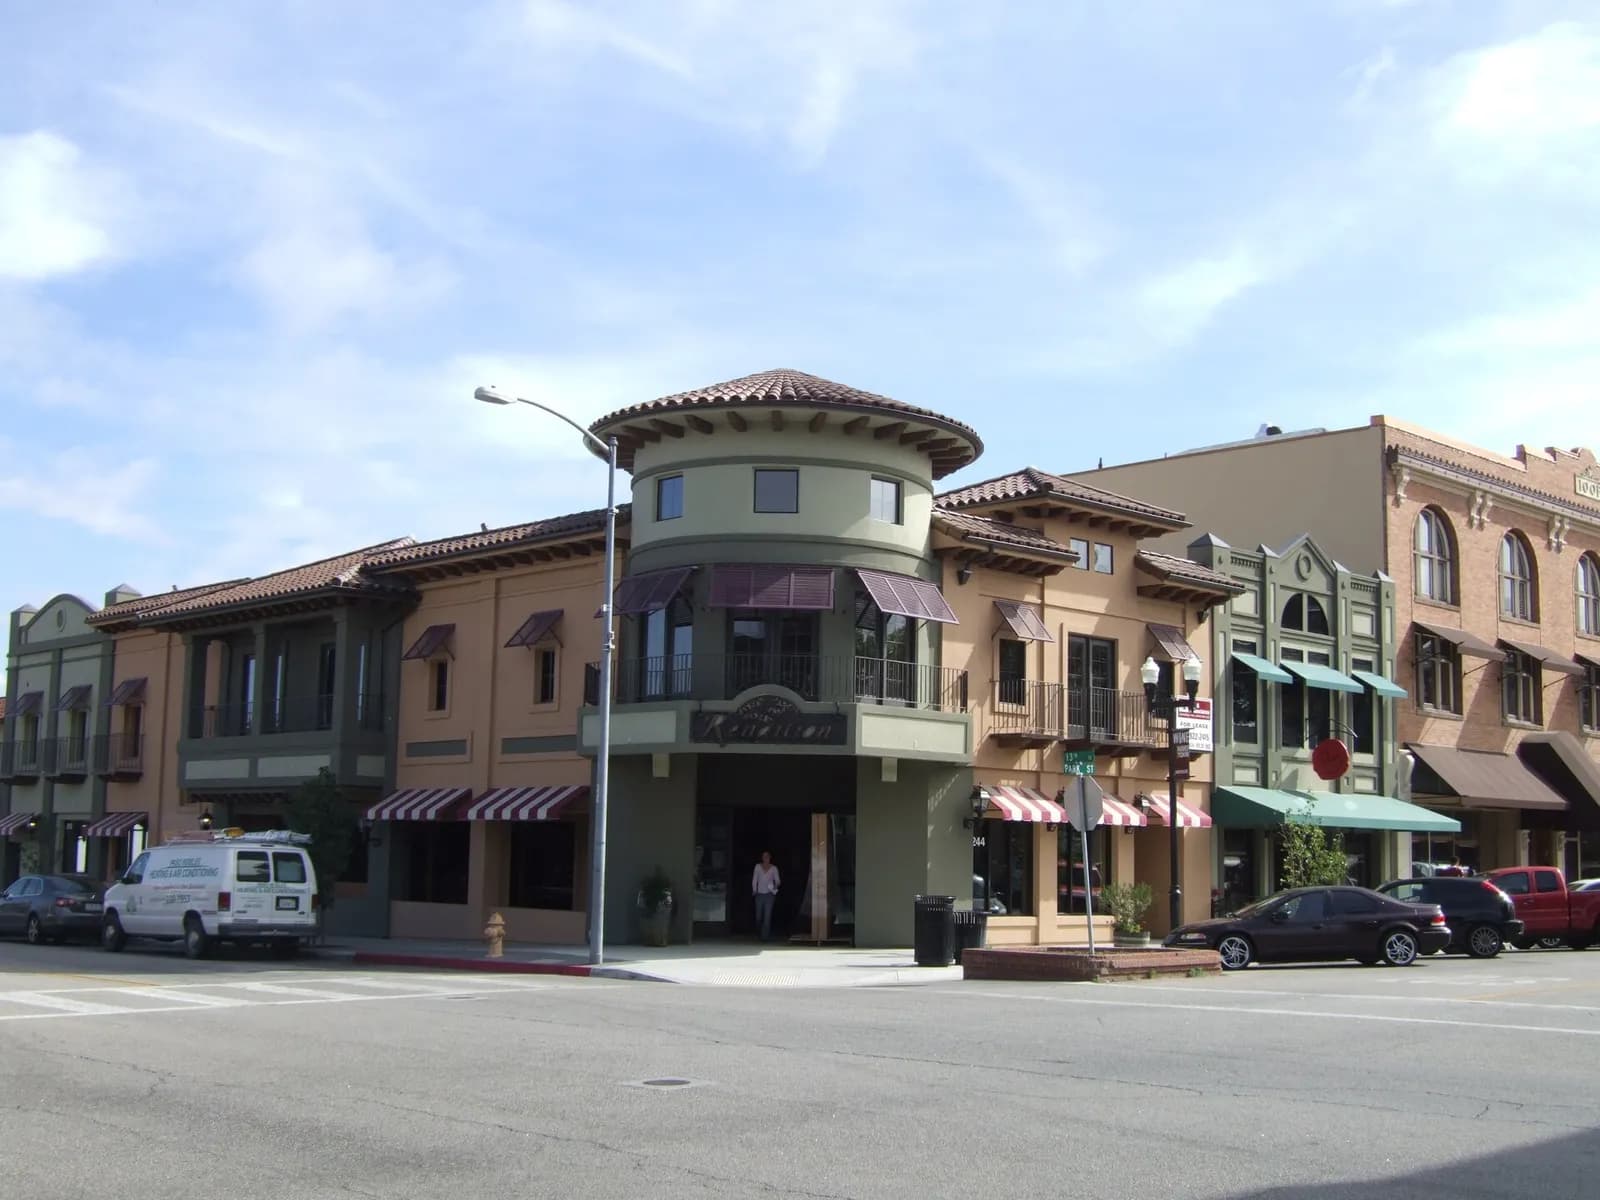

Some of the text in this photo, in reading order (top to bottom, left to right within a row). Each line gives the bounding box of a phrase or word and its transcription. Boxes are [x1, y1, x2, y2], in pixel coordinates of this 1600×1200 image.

[1064, 763, 1094, 774] PARK ST
[182, 867, 219, 878] CONDITIONING
